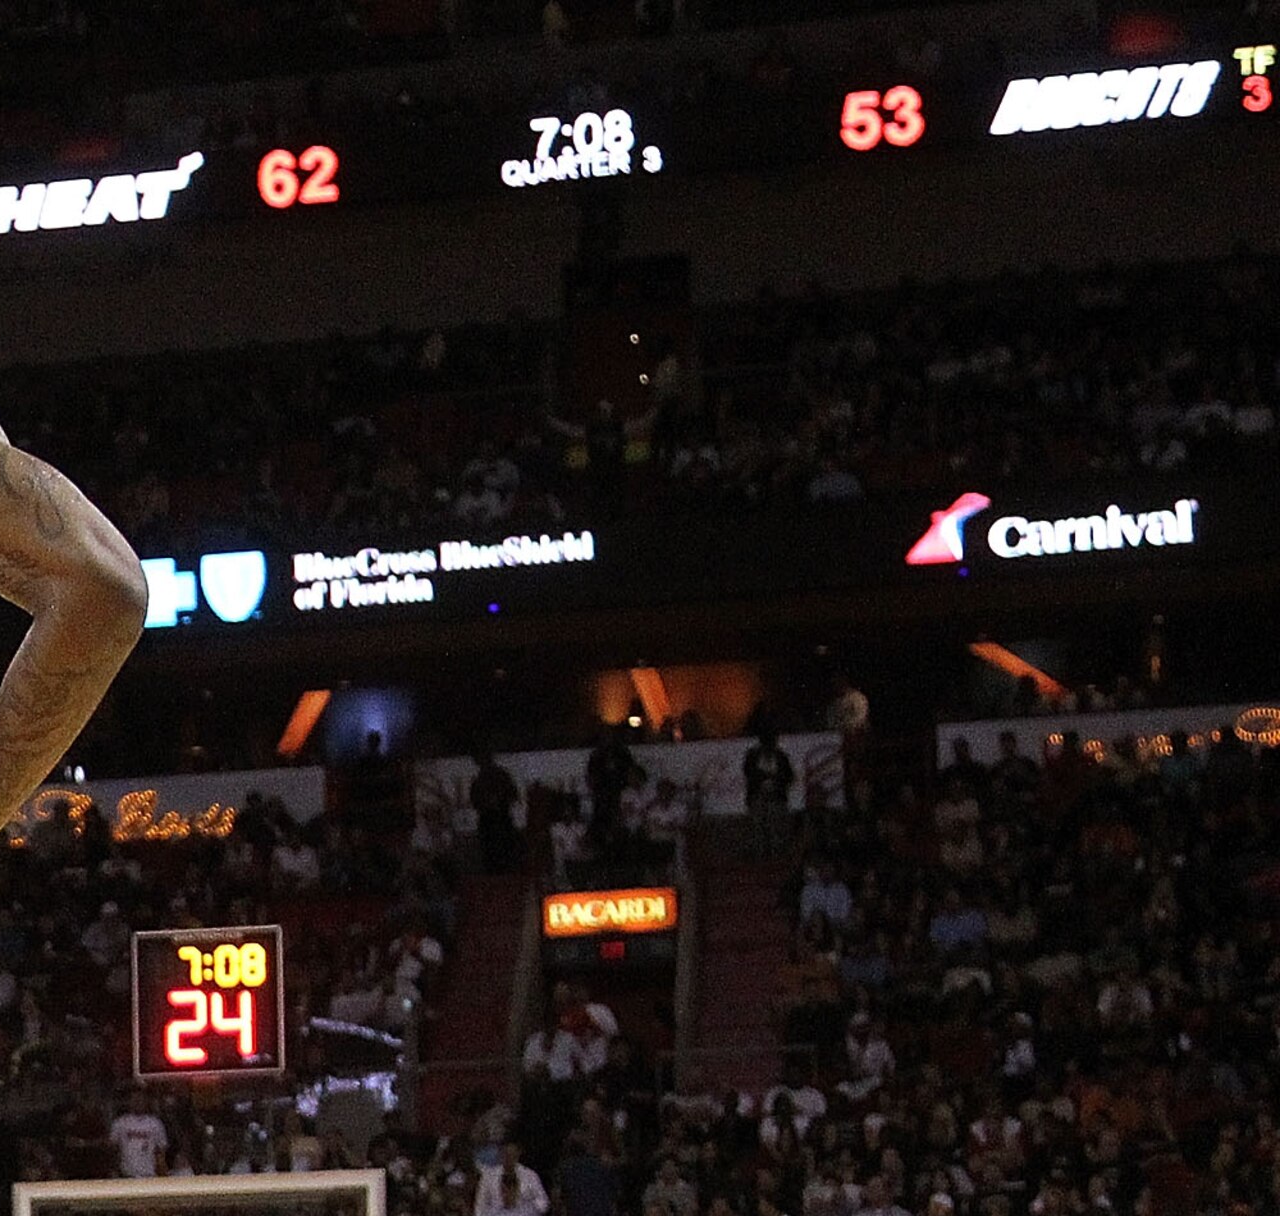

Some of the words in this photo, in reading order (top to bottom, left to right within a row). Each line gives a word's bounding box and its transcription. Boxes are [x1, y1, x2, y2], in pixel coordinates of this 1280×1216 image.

[1234, 45, 1276, 75] TF
[1243, 75, 1272, 112] 3
[530, 109, 634, 161] 7:08
[840, 86, 925, 150] 53
[258, 146, 339, 208] 62
[502, 150, 630, 187] QUARTER
[643, 146, 662, 173] 3
[988, 499, 1194, 558] Carnival
[294, 581, 327, 610] of
[548, 896, 667, 928] BACARDI
[178, 942, 267, 988] 7:08
[165, 989, 257, 1066] 24
